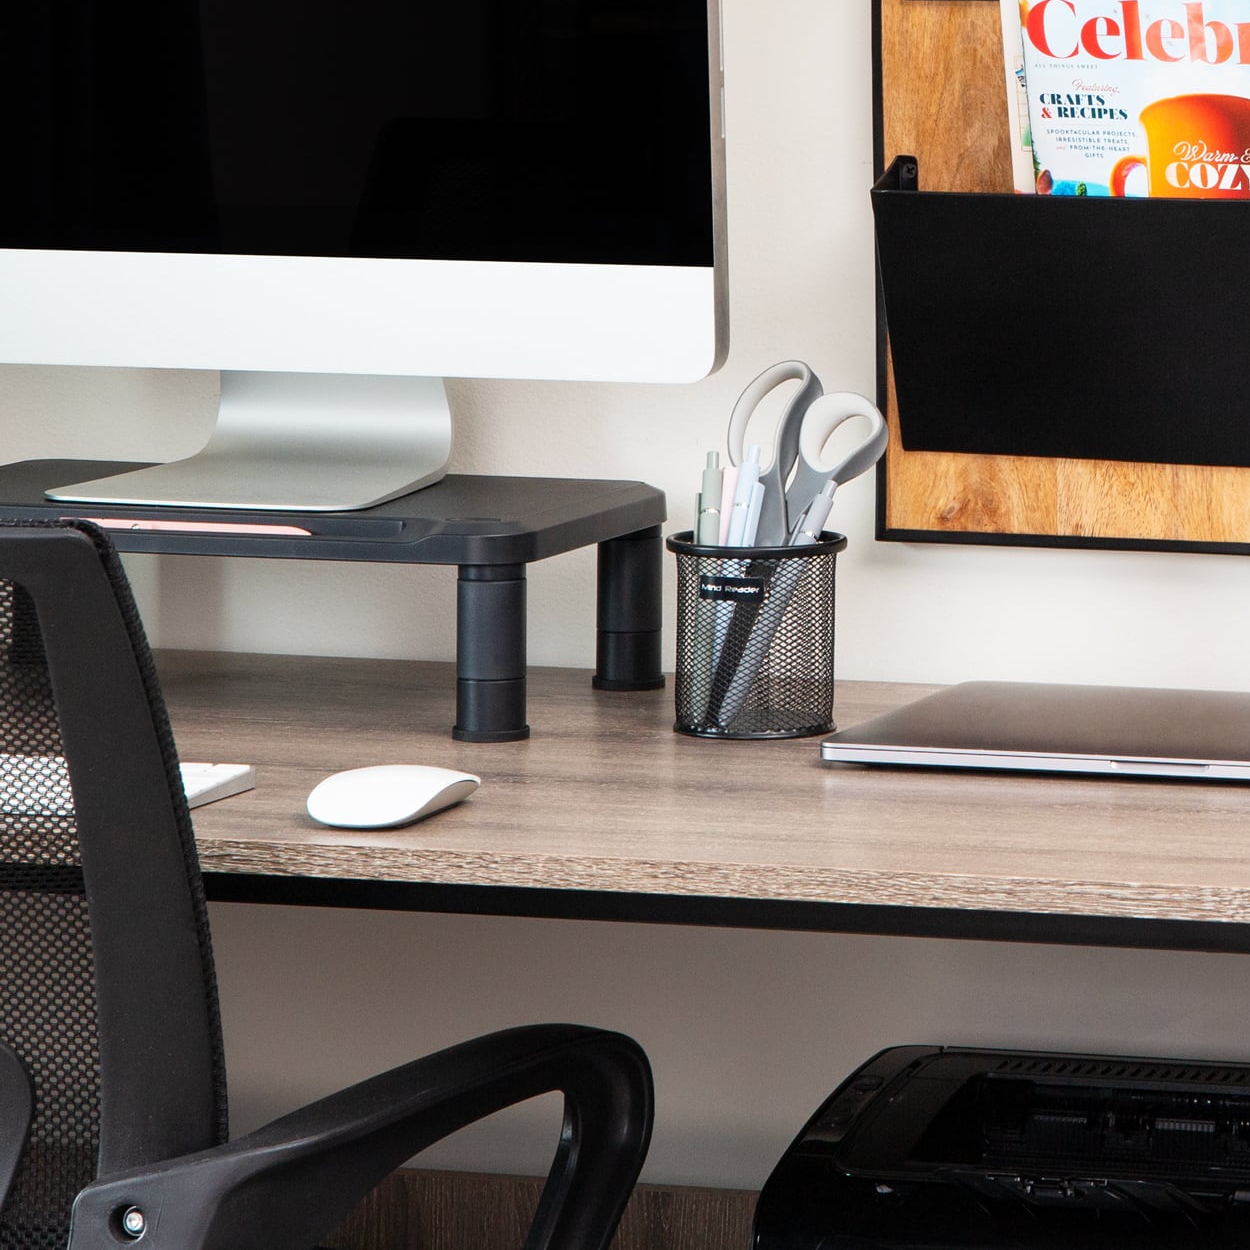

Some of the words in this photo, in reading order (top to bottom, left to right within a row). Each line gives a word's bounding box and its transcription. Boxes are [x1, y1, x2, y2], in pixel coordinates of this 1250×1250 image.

[1039, 93, 1106, 106] CRAFTS
[1041, 107, 1053, 119] &
[1056, 106, 1129, 121] RECIPES
[1046, 128, 1101, 136] SPOOKTACULAR
[1102, 130, 1136, 138] PROJECTS
[1055, 136, 1101, 144] IRRESISTIBLE
[1173, 140, 1239, 163] Warm
[701, 583, 722, 592] Mind
[724, 585, 760, 594] Reader
